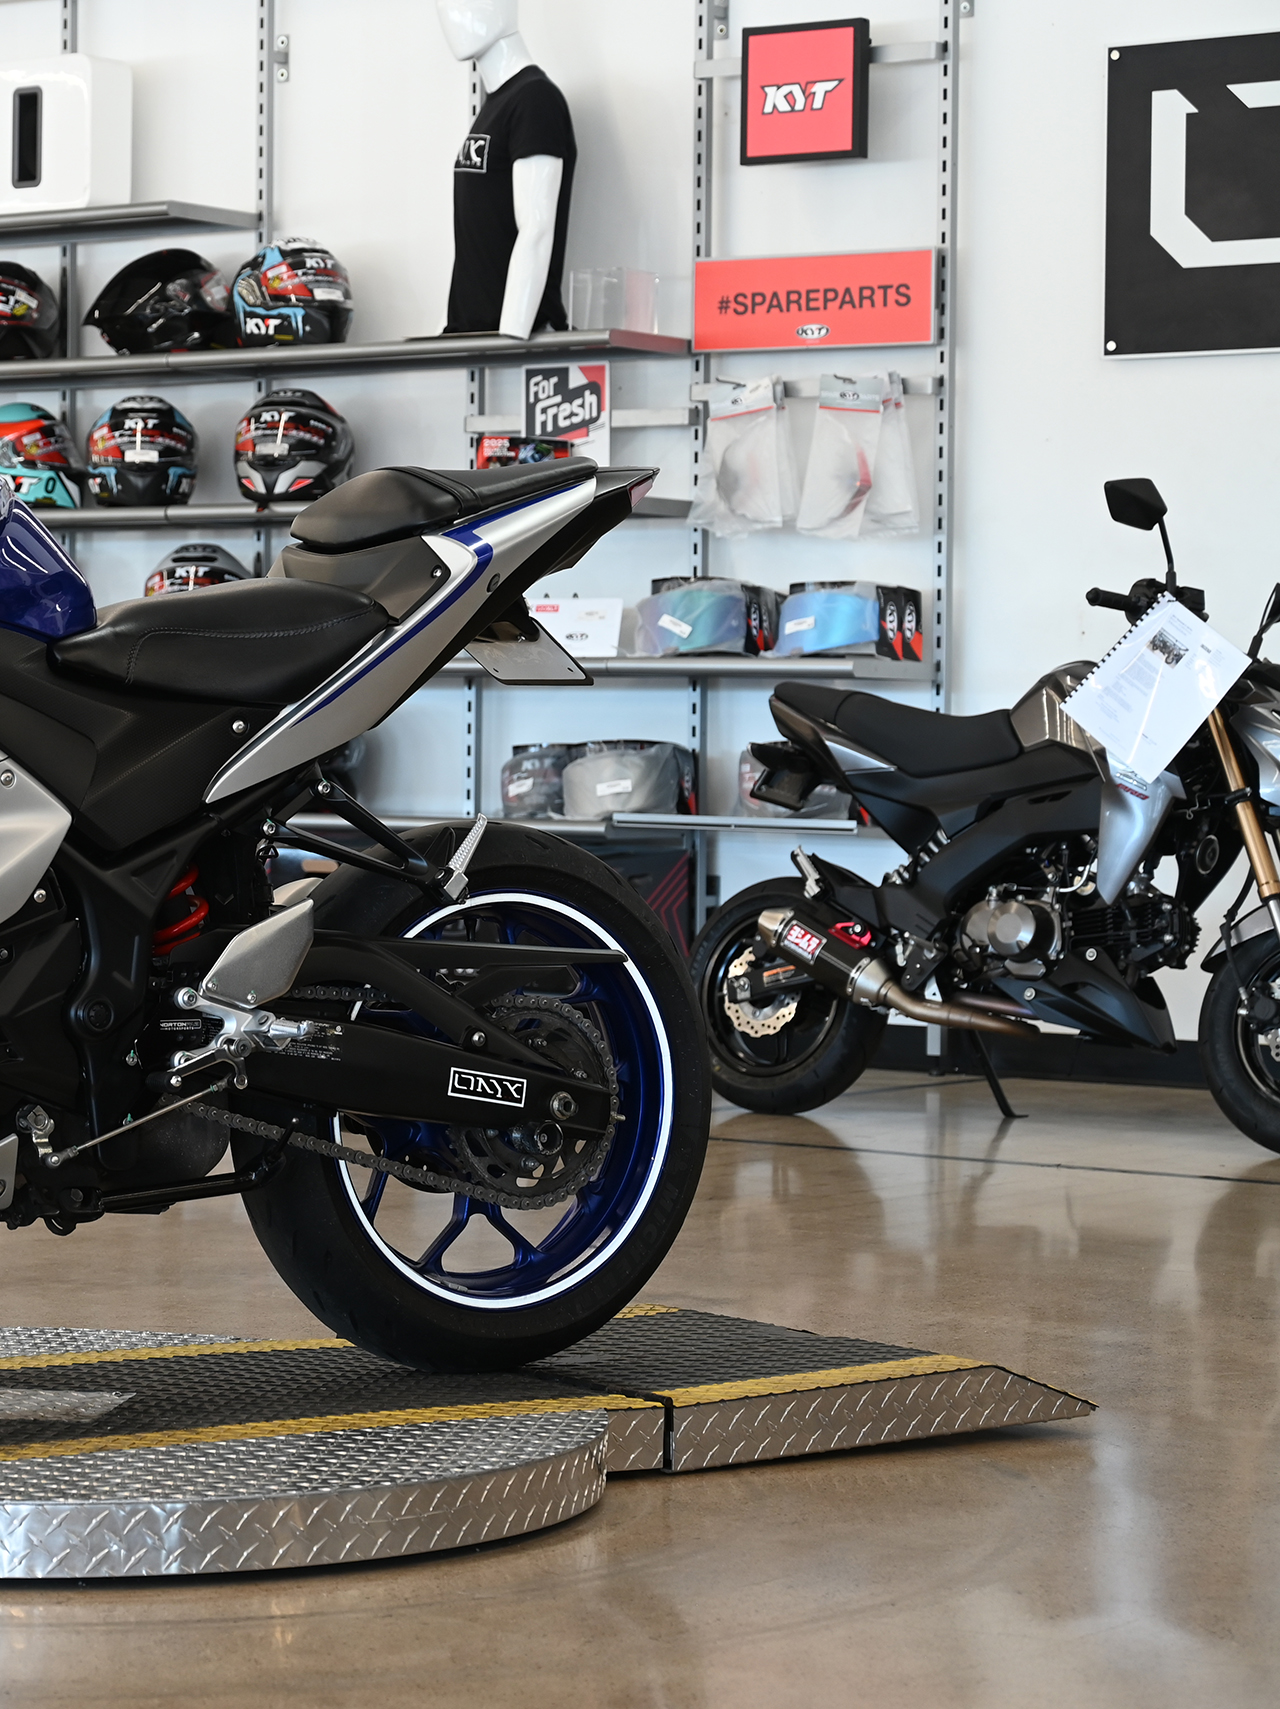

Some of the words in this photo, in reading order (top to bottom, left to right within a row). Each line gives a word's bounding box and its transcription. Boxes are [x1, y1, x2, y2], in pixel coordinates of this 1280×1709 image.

[760, 78, 845, 115] KYT
[305, 257, 335, 269] KYT
[717, 283, 912, 316] #SPAREPARTS
[245, 317, 282, 335] KYT
[529, 374, 558, 403] For
[535, 389, 598, 436] Fresh
